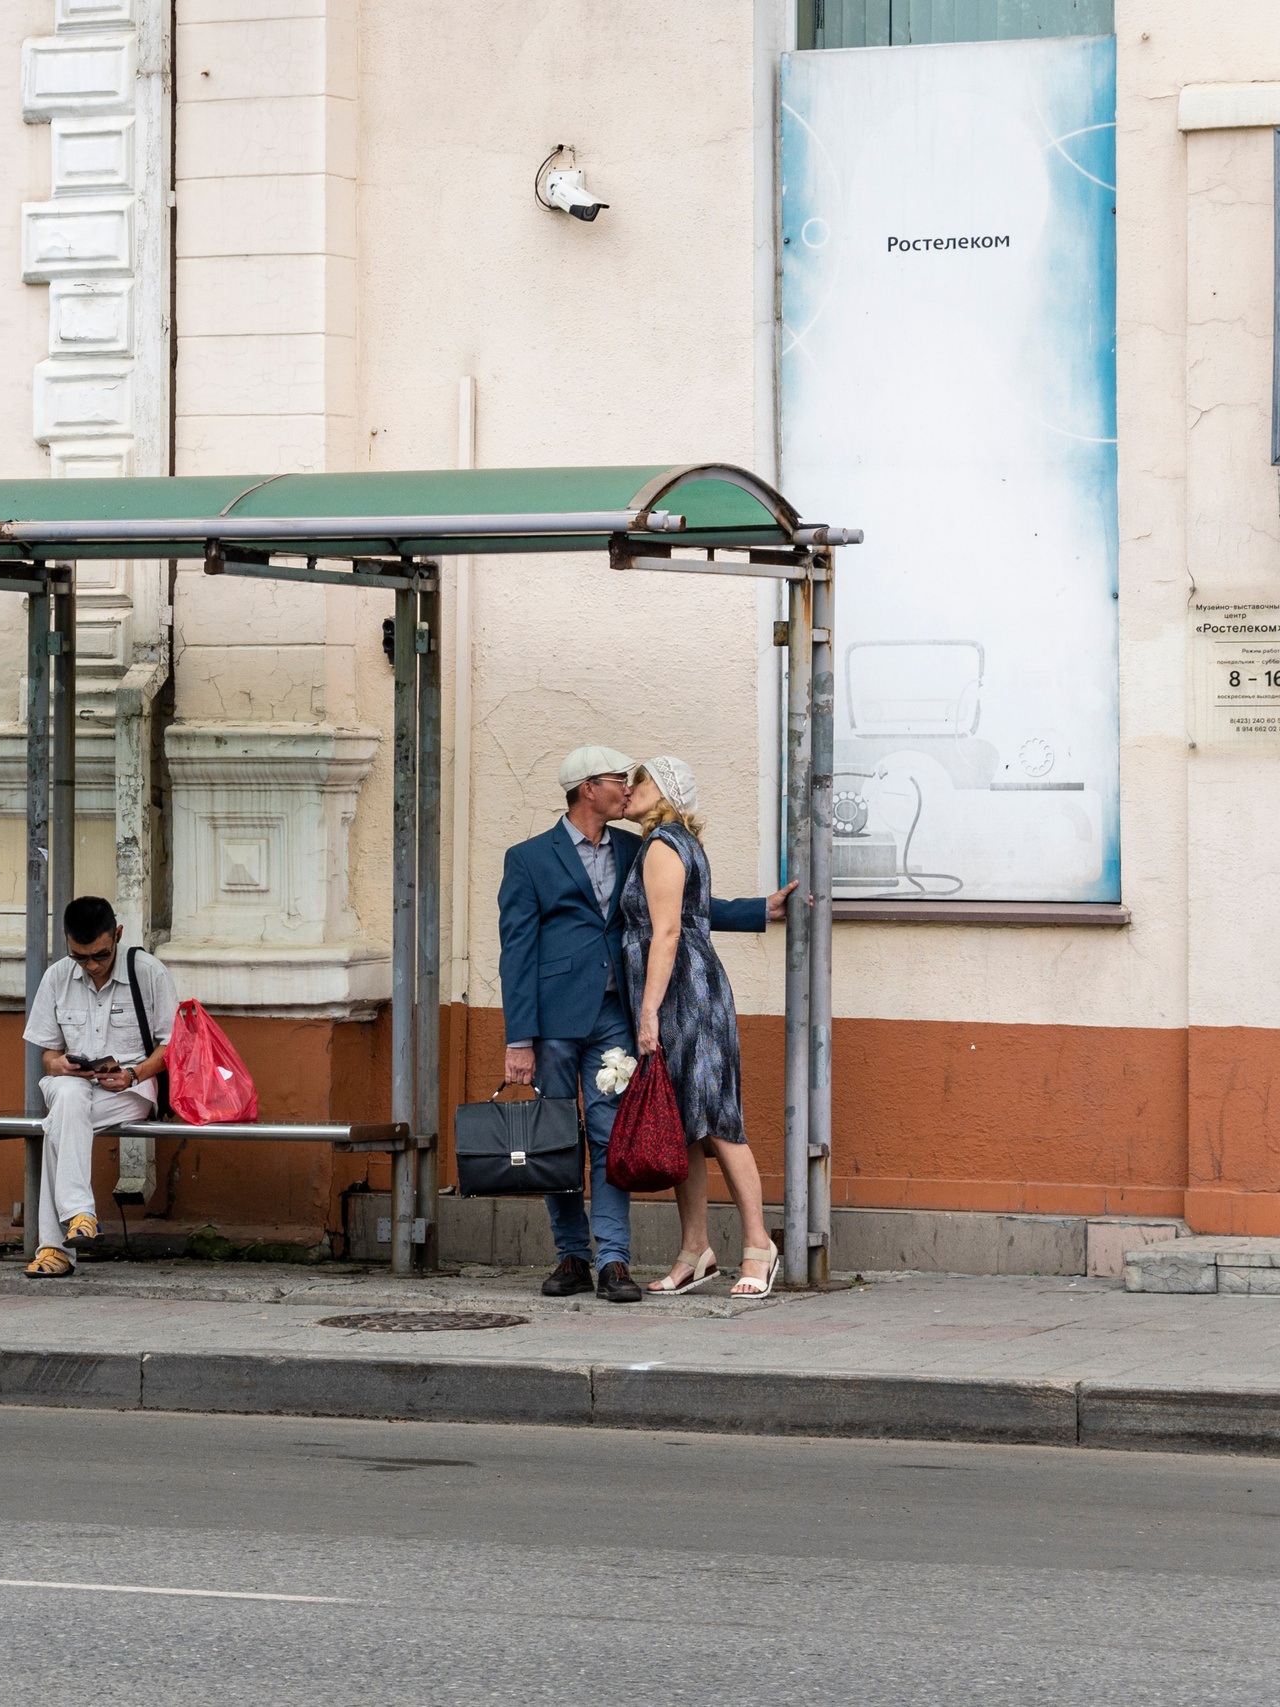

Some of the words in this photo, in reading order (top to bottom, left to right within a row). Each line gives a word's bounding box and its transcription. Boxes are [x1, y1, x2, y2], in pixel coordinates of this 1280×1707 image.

[887, 235, 1010, 252] Ростелеком
[1224, 612, 1247, 620] центр
[1229, 670, 1241, 687] 8
[1264, 670, 1280, 687] 16
